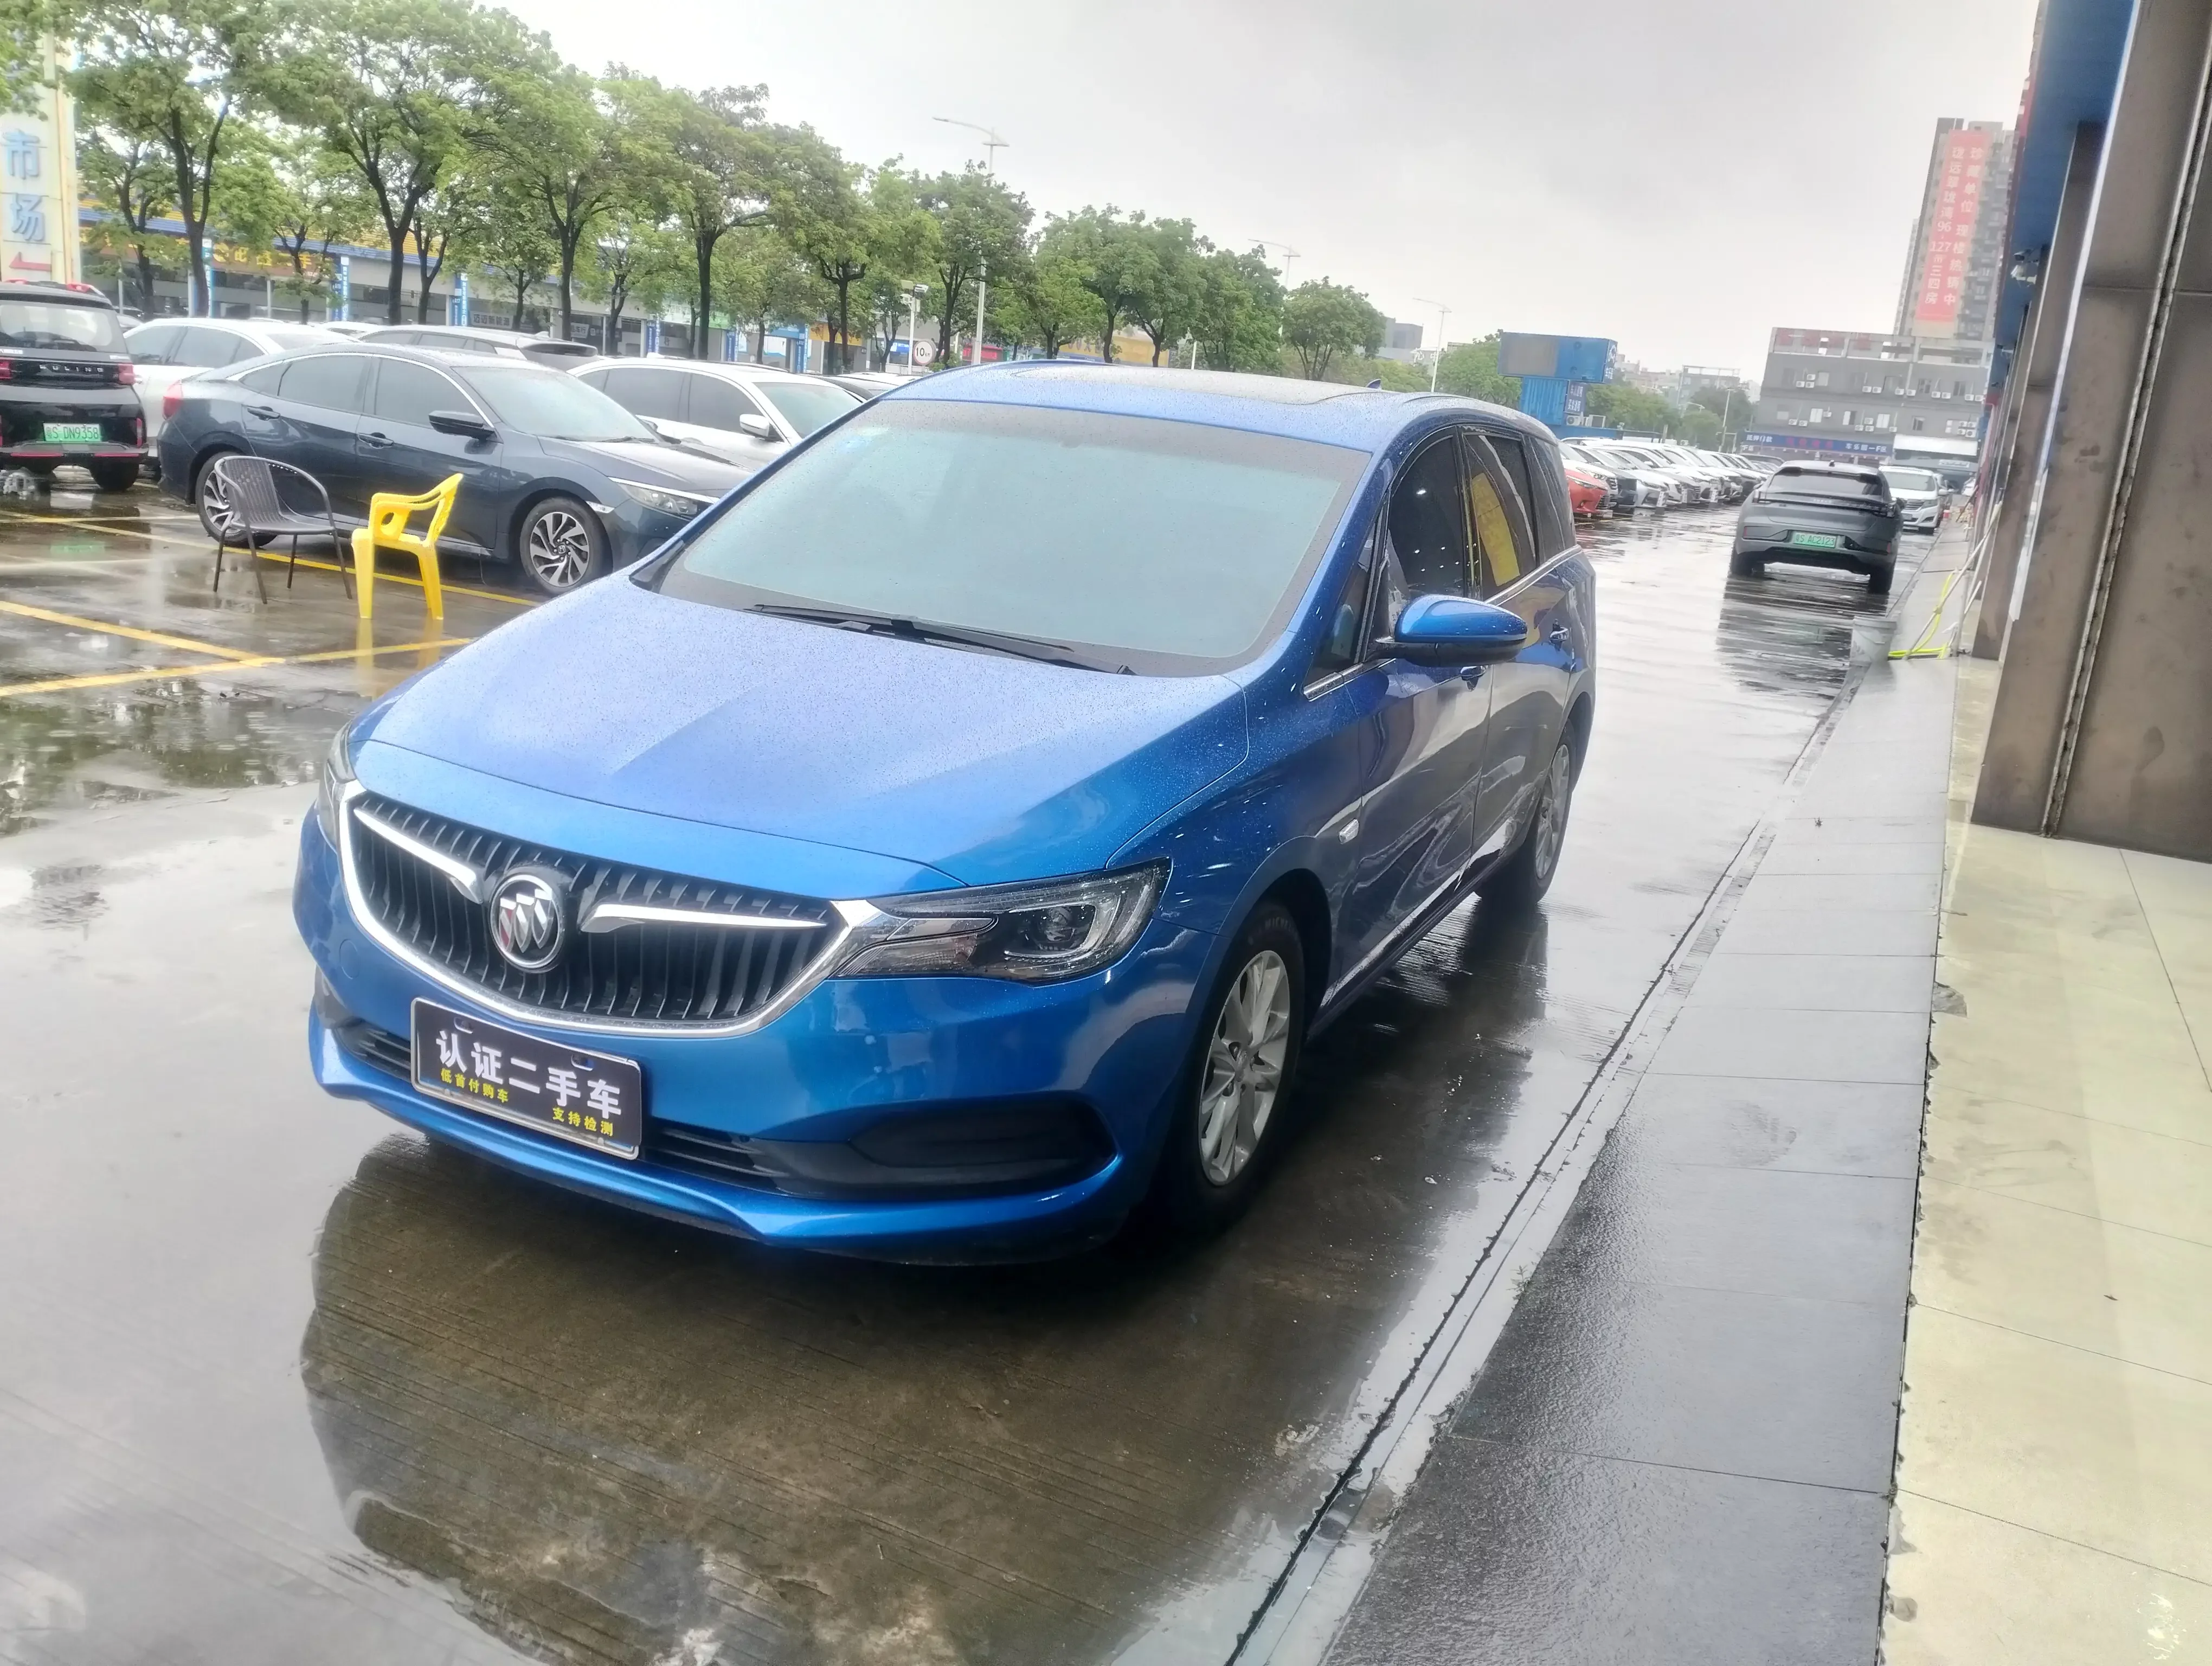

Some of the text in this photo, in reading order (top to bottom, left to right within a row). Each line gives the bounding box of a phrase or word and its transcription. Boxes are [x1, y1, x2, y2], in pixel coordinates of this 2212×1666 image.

[2, 129, 46, 242] 市场
[436, 1030, 622, 1119] 认证二手车
[440, 1068, 509, 1103] 低首付购车
[552, 1107, 614, 1137] 支持检测
